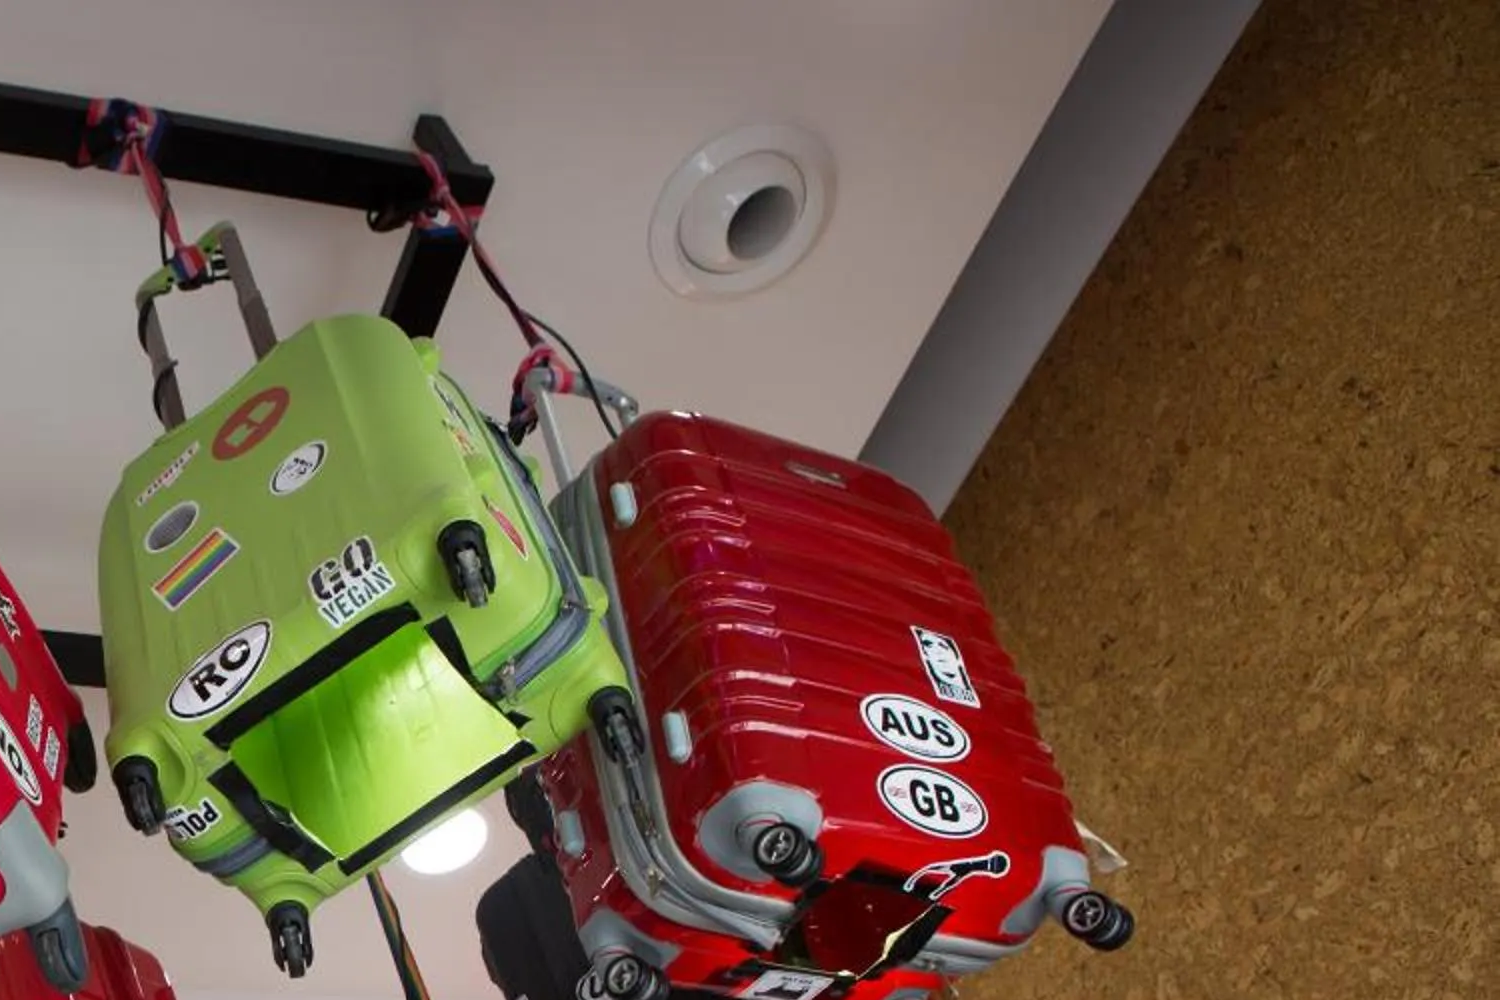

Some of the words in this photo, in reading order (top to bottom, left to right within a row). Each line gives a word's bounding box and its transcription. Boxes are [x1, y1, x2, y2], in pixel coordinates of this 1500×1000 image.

[311, 538, 373, 600] GO
[321, 566, 393, 624] VEGAN
[881, 708, 956, 748] AUS
[909, 777, 958, 824] GB
